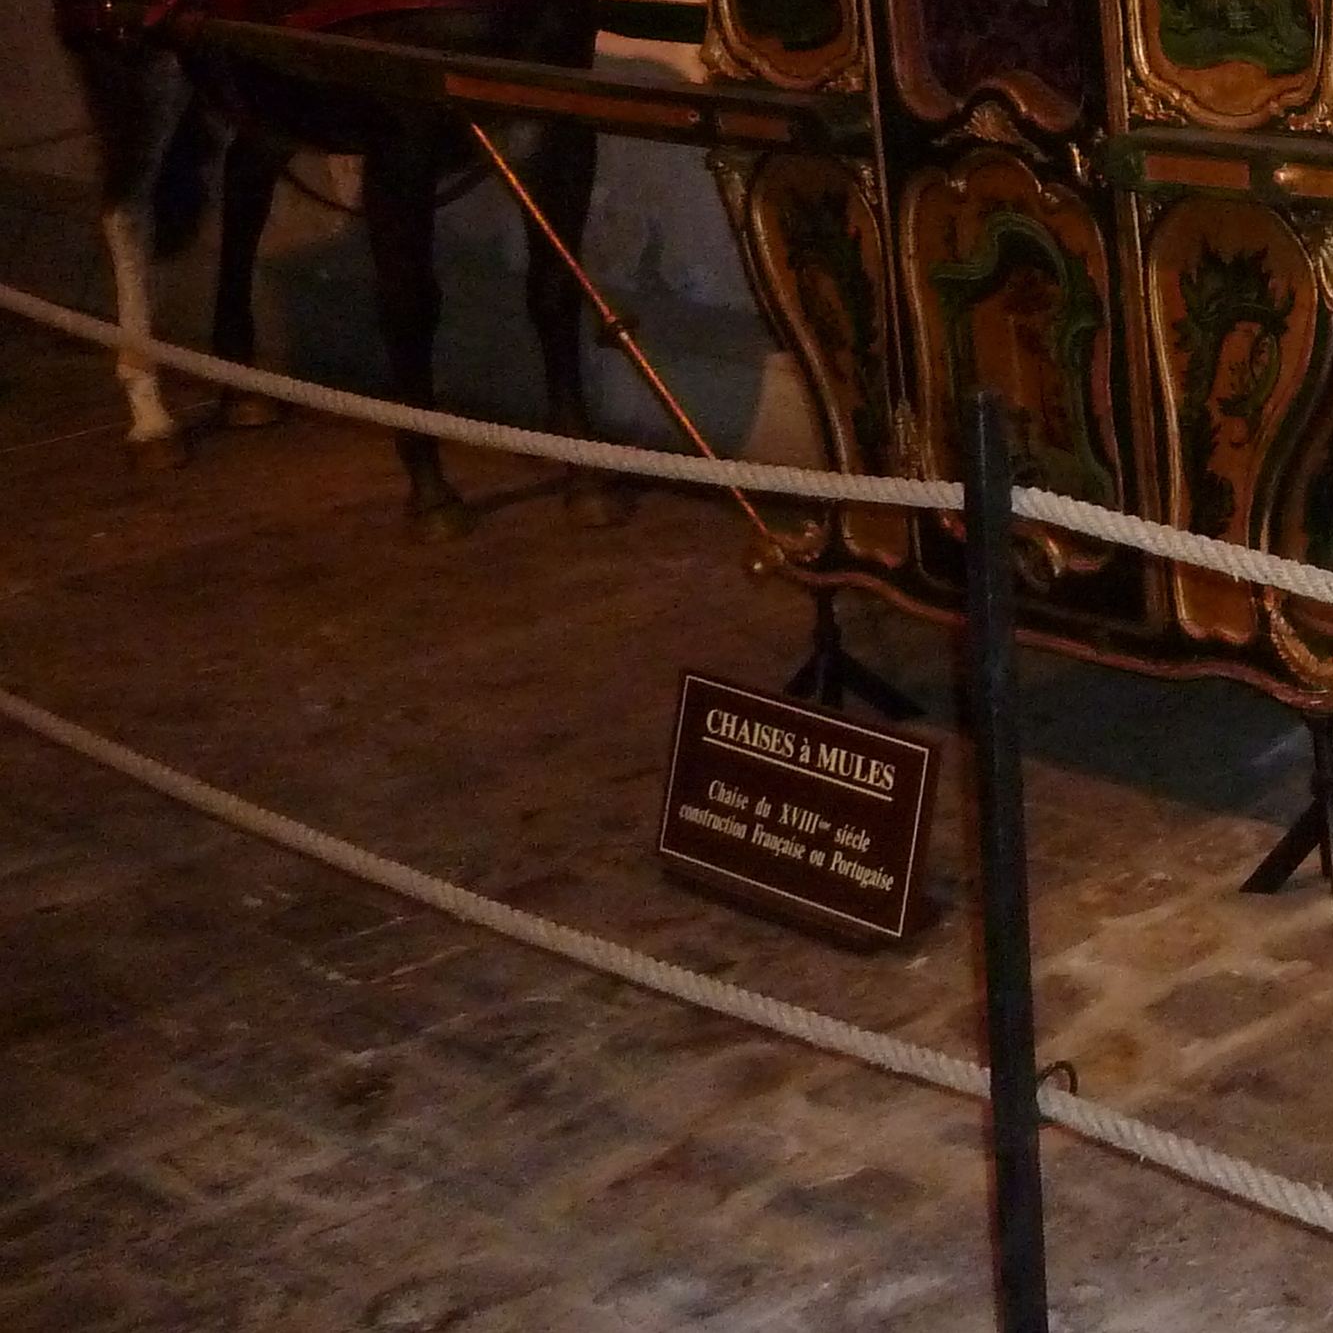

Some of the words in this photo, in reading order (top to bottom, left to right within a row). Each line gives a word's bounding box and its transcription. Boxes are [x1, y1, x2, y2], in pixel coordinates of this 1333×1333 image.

[706, 709, 795, 758] CHAISES
[799, 737, 811, 763] à
[818, 743, 896, 791] MULES
[708, 780, 748, 810] Chaise
[755, 796, 771, 818] du
[679, 804, 747, 839] construction
[751, 824, 806, 859] Française
[809, 849, 825, 866] ou
[830, 850, 893, 891] Portugaise
